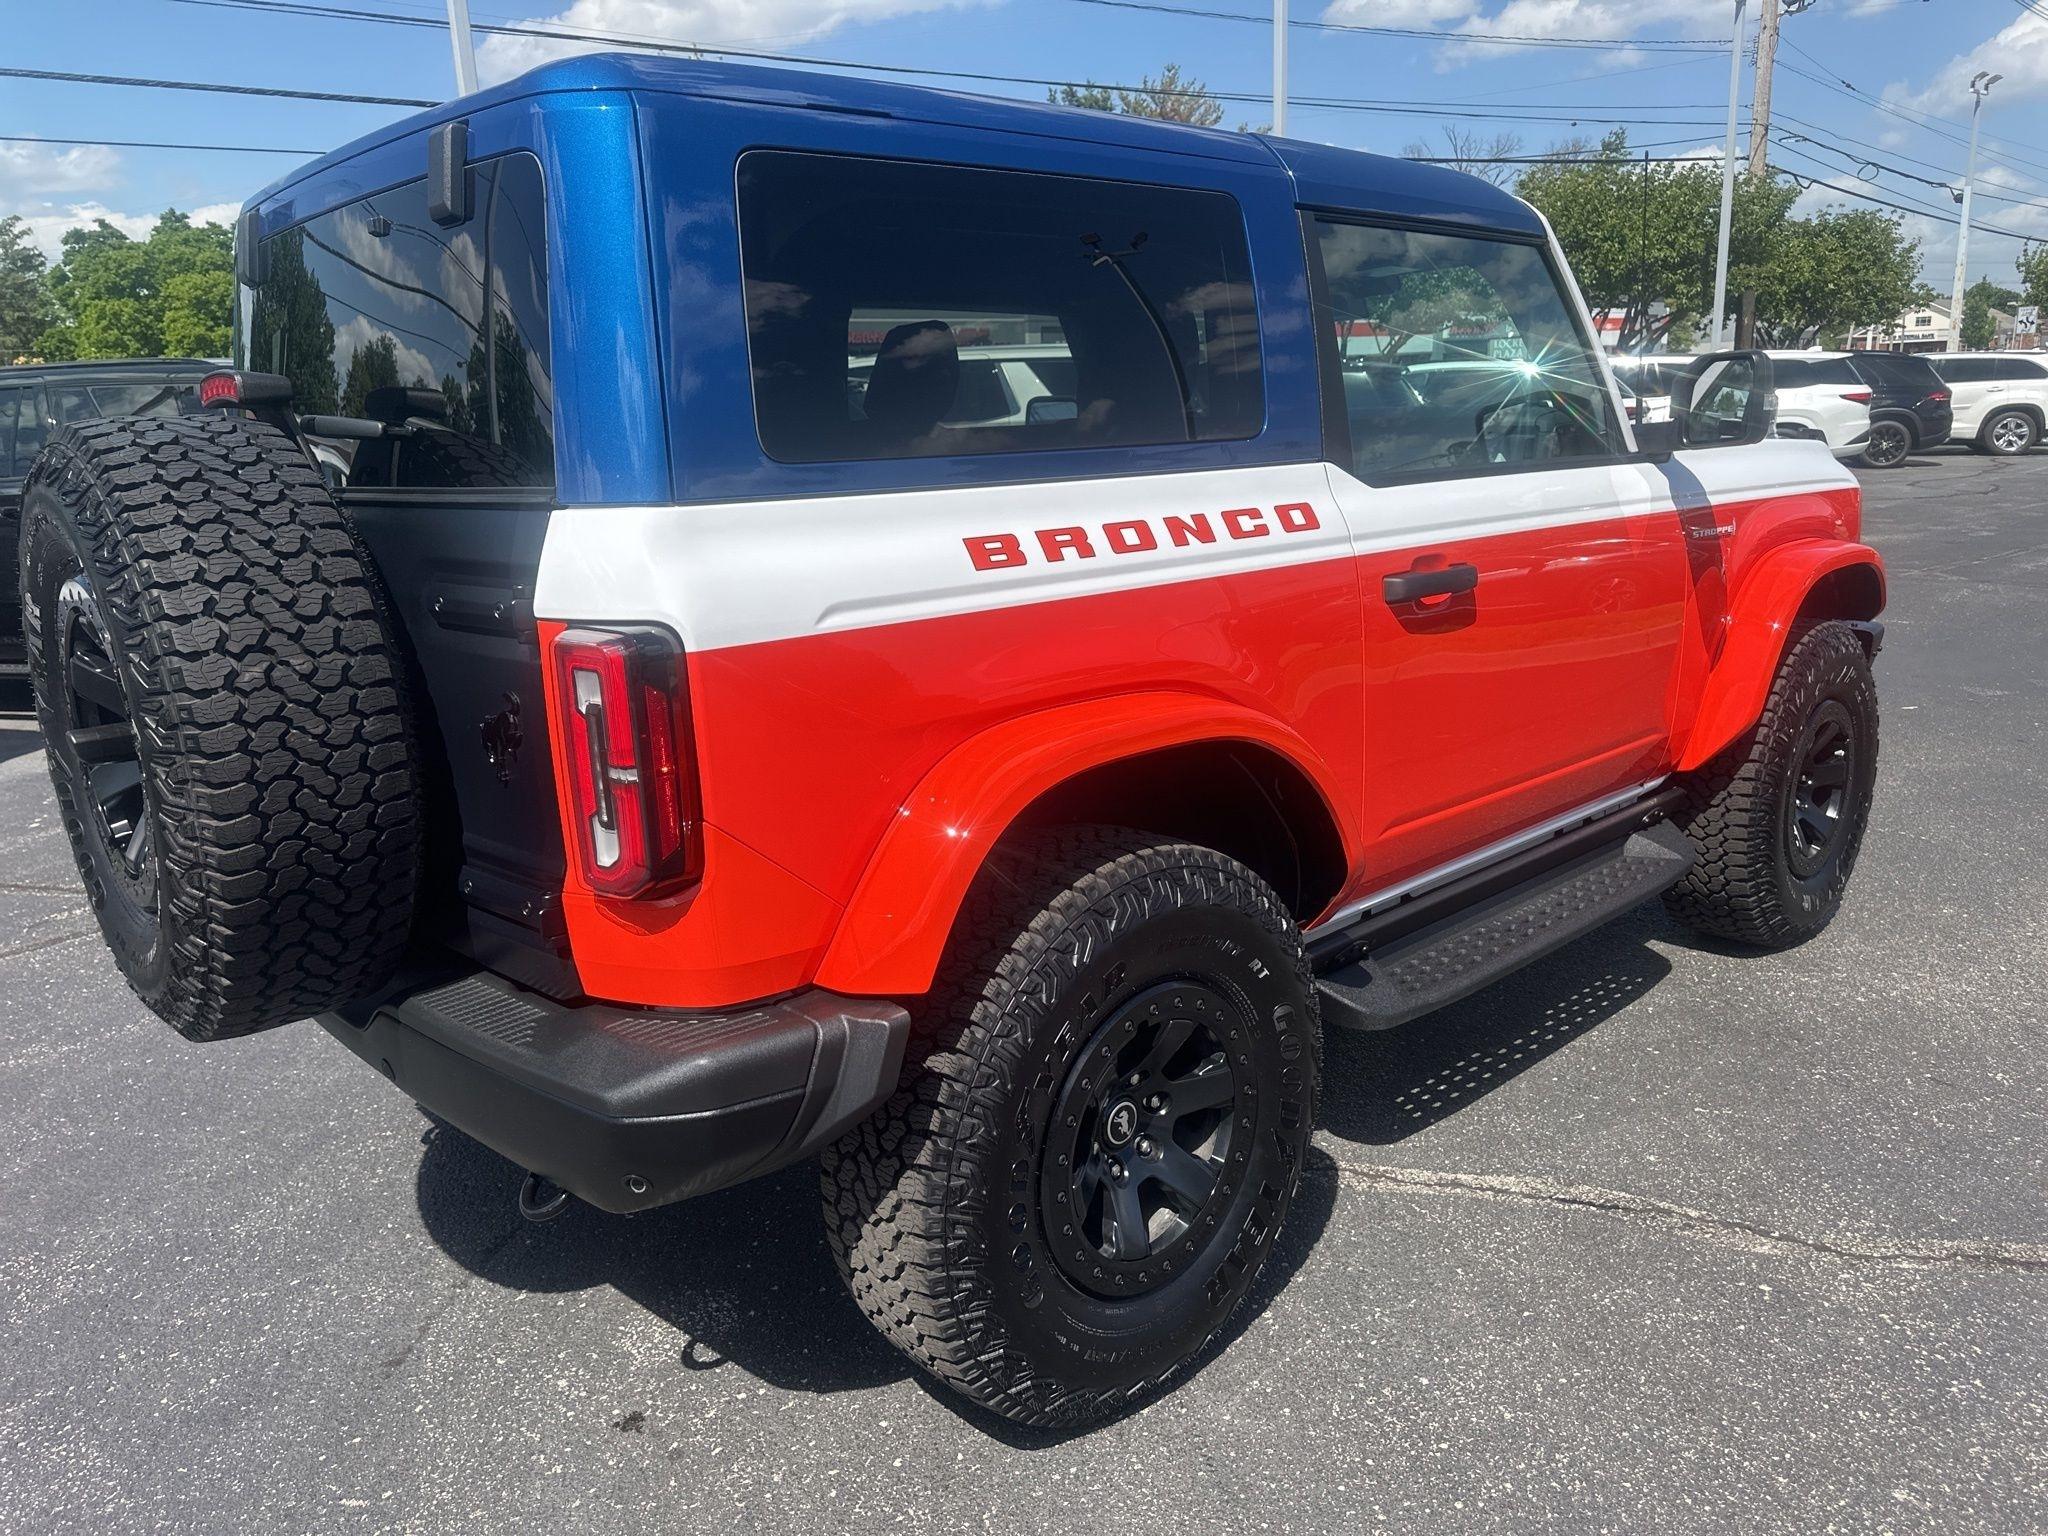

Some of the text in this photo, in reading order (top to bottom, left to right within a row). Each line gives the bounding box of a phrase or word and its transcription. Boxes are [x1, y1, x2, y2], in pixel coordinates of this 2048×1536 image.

[962, 502, 1320, 571] BRONCO
[1692, 525, 1734, 538] STROPPE
[1248, 957, 1270, 979] RT
